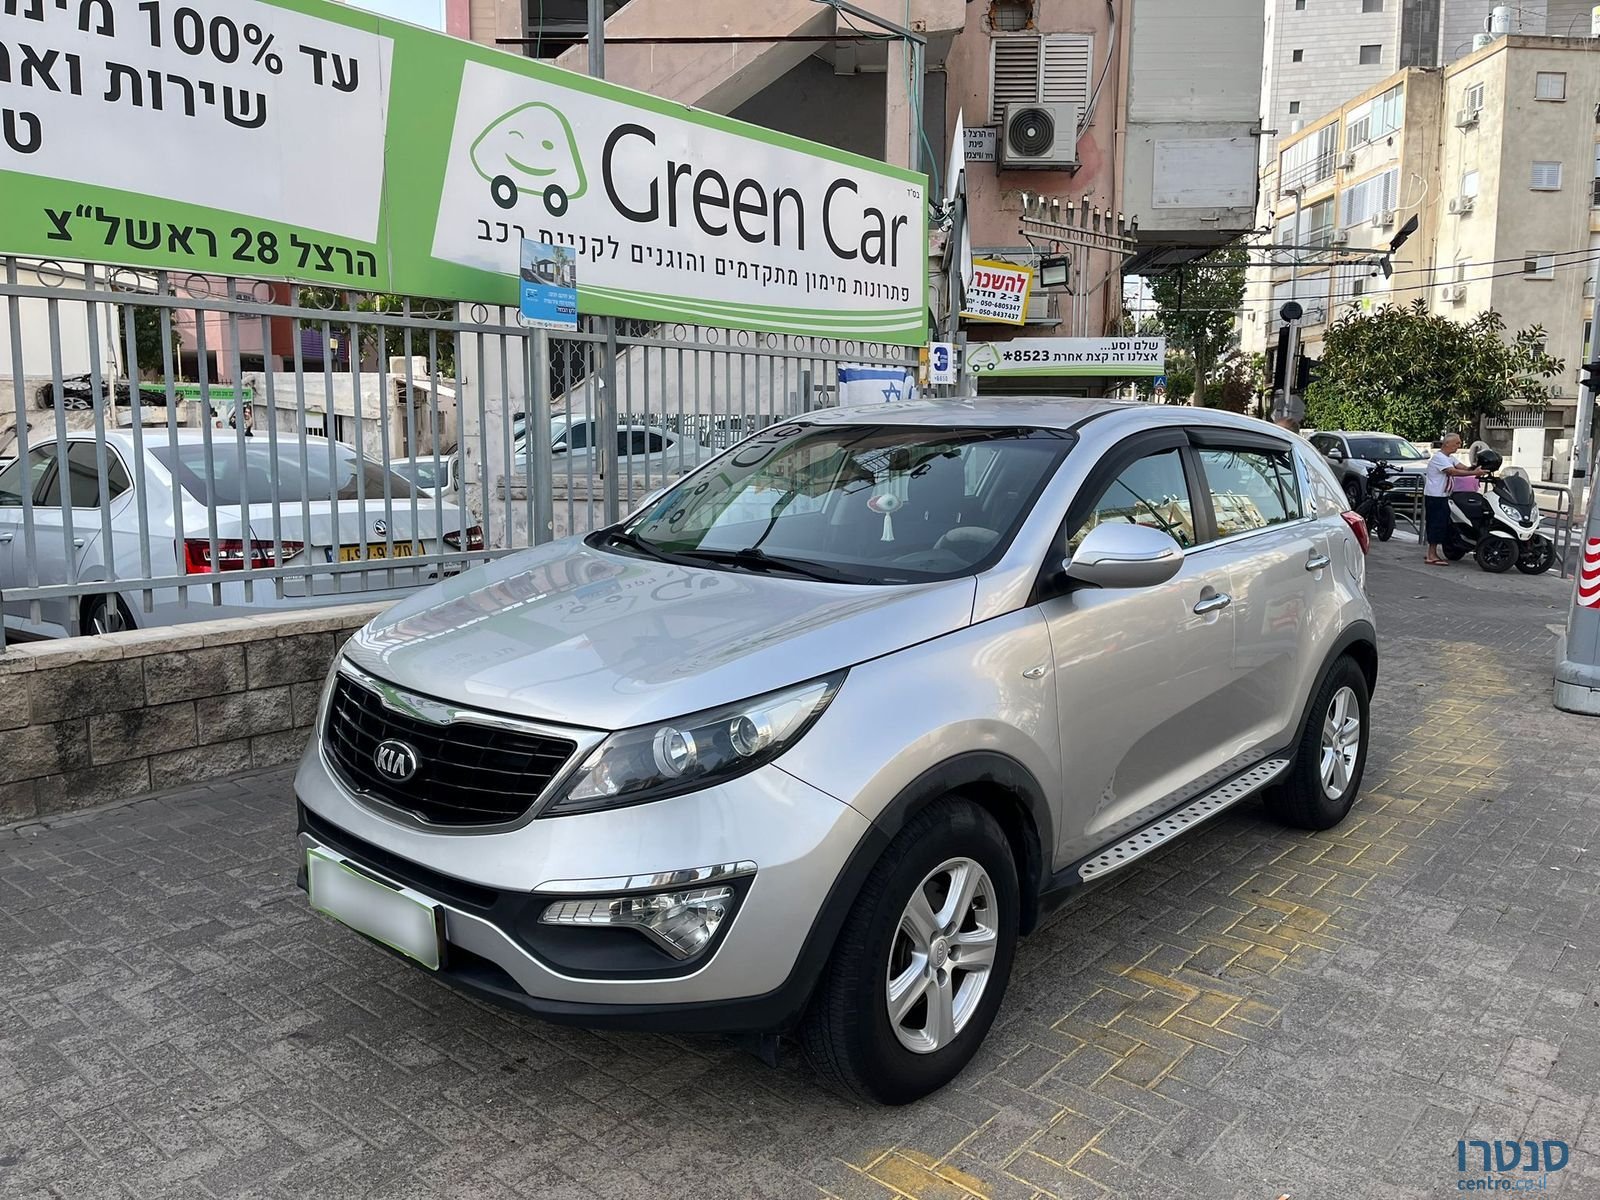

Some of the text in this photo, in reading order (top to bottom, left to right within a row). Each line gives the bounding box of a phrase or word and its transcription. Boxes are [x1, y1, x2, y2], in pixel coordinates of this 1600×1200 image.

[138, 1, 283, 75] 100%
[299, 44, 360, 93] עד
[0, 40, 267, 129] שירות וא
[968, 129, 986, 138] הרצל
[968, 140, 984, 148] פינת
[601, 123, 908, 268] Green Car
[230, 226, 280, 265] 28
[290, 234, 377, 278] הרצל
[632, 245, 705, 273] והוגנים
[715, 258, 798, 287] מתקדמים
[805, 271, 847, 293] מימון
[852, 279, 910, 302] פתרונות
[1053, 353, 1083, 362] אחרת
[1112, 353, 1126, 362] זה
[1127, 351, 1158, 362] אצלנו
[1134, 339, 1159, 351] שלם
[1086, 353, 1109, 363] קצת
[377, 746, 406, 776] KIA
